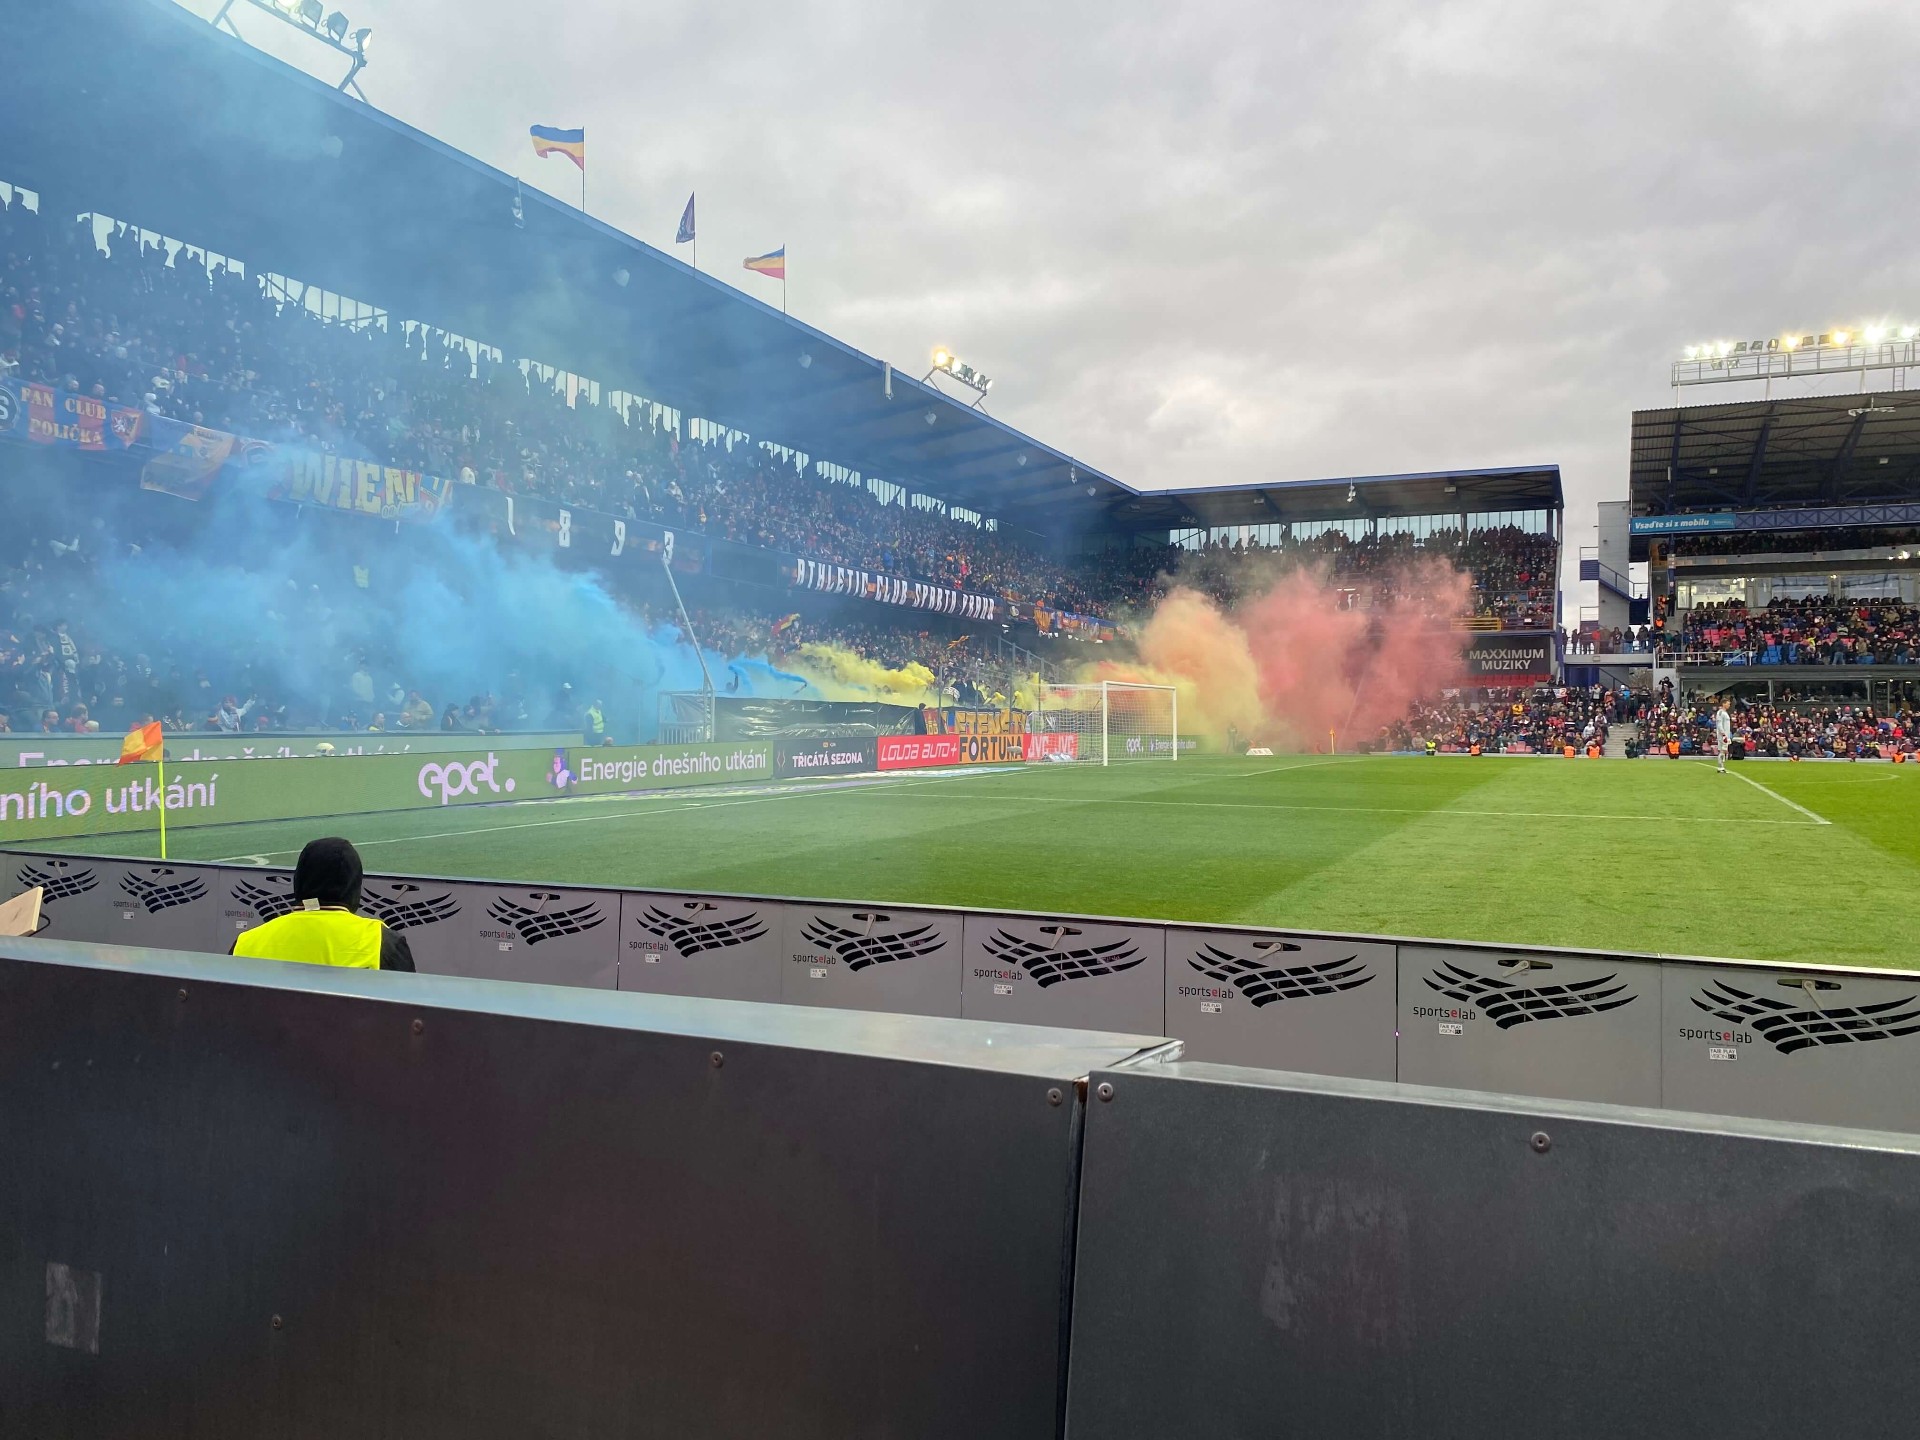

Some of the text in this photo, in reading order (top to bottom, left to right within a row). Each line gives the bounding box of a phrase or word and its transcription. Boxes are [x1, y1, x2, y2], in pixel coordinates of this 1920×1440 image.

[64, 398, 107, 420] CLUB
[30, 418, 104, 445] POLIČKA
[289, 451, 417, 514] WIEN
[1665, 519, 1673, 528] si
[1680, 518, 1709, 527] mobilu
[796, 558, 995, 620] ATHLETIC CLUB SPARTA PRAHA
[1469, 648, 1544, 660] MAXXIMUM
[1481, 659, 1531, 671] MUZIKY
[960, 736, 1023, 761] FORTUNA
[580, 748, 767, 783] Energie dnešního utkání
[792, 750, 863, 768] TŘICÁTÁ SEZONA
[0, 773, 219, 821] ního utkání
[480, 930, 516, 940] sportselab
[629, 941, 669, 951] sportselab
[792, 954, 836, 965] sportselab
[974, 968, 1023, 980] sportselab
[1178, 986, 1234, 999] sportselab
[1413, 1006, 1476, 1020] sportselab
[1680, 1028, 1752, 1044] sportselab
